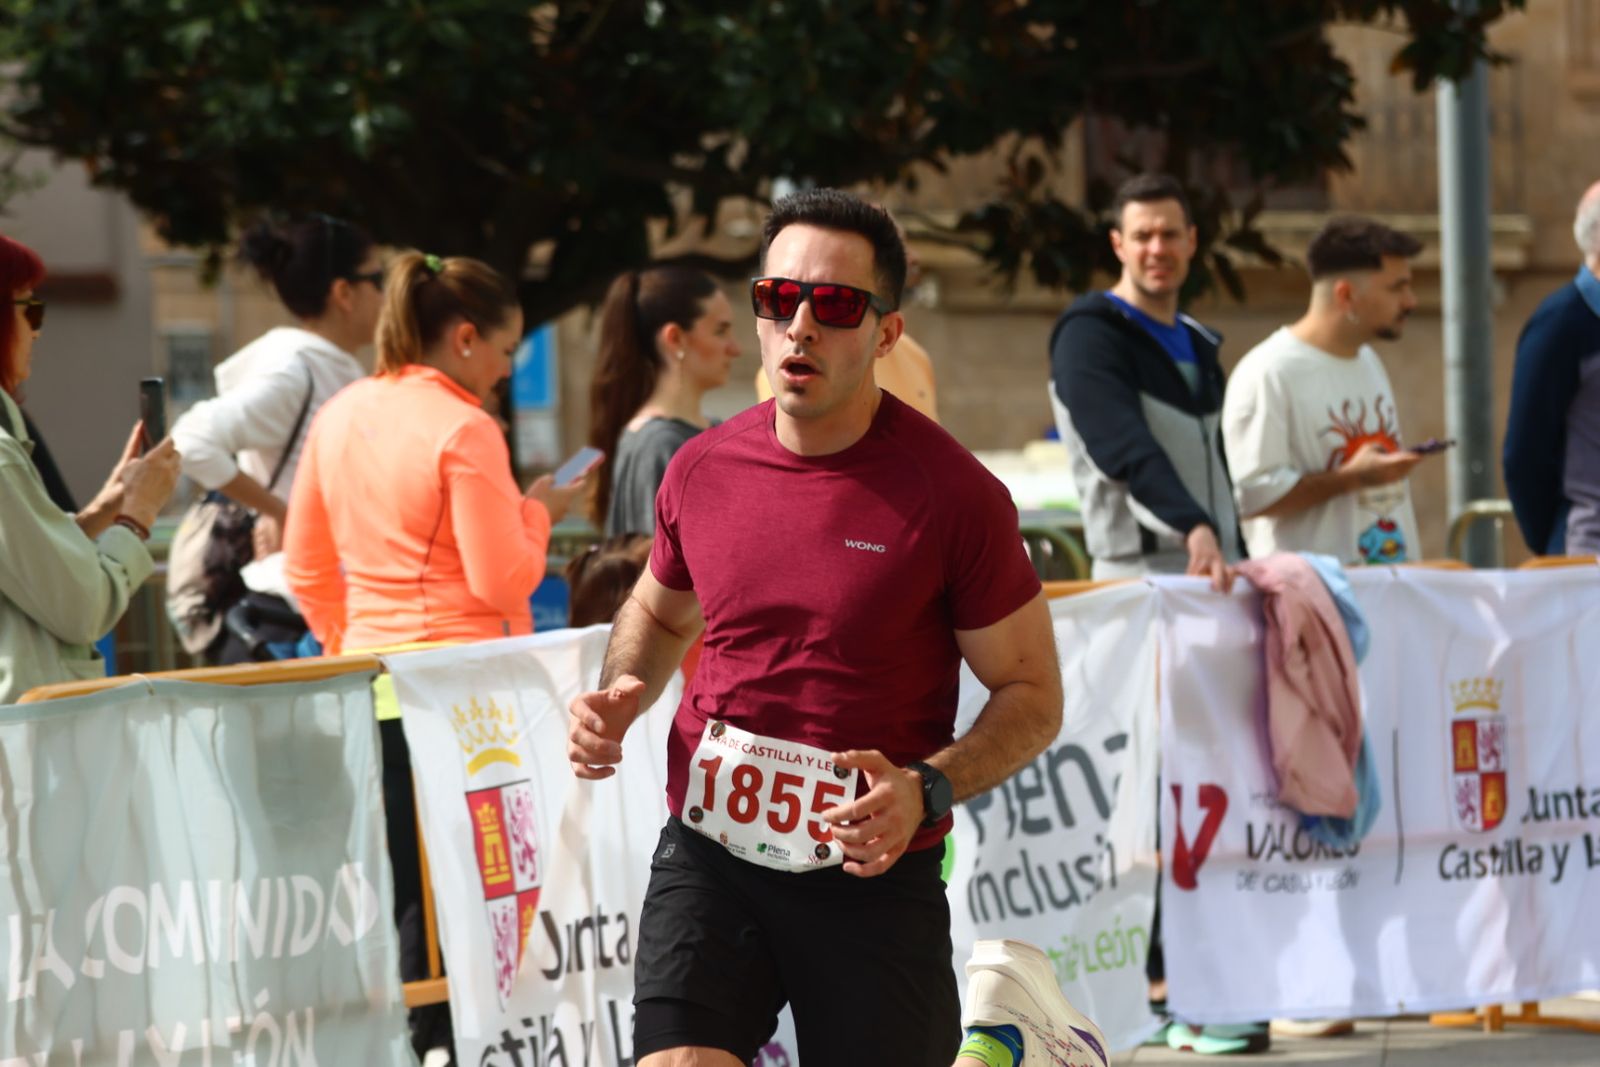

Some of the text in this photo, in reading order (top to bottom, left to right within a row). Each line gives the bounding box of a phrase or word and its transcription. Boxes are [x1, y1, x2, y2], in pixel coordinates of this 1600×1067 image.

[844, 538, 886, 553] WONG
[741, 742, 803, 764] CASTILLA
[806, 756, 815, 767] Y
[698, 755, 846, 843] 1855
[1521, 784, 1600, 824] Junta
[767, 843, 791, 857] Plena
[1438, 837, 1543, 881] Castilla
[1551, 842, 1570, 883] y
